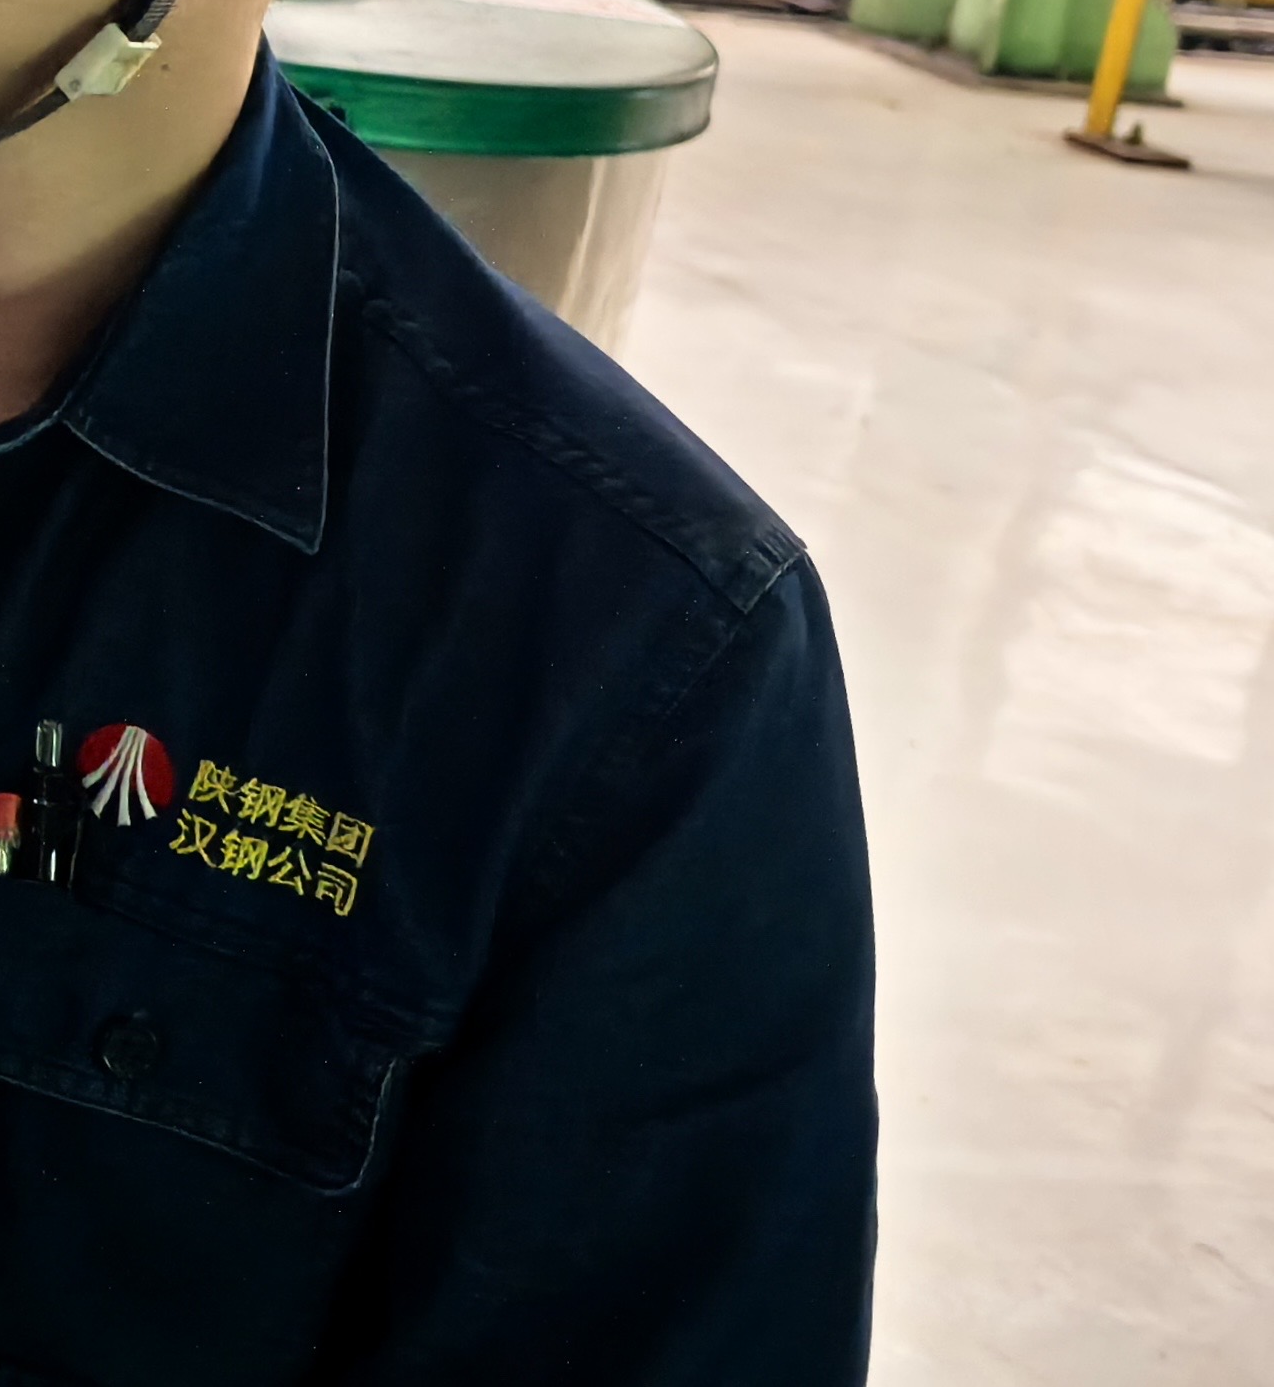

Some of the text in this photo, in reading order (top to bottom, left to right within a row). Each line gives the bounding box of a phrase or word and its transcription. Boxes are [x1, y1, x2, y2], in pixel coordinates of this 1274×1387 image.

[169, 808, 359, 917] 汉钢公司
[189, 759, 375, 868] 陕钢集团
